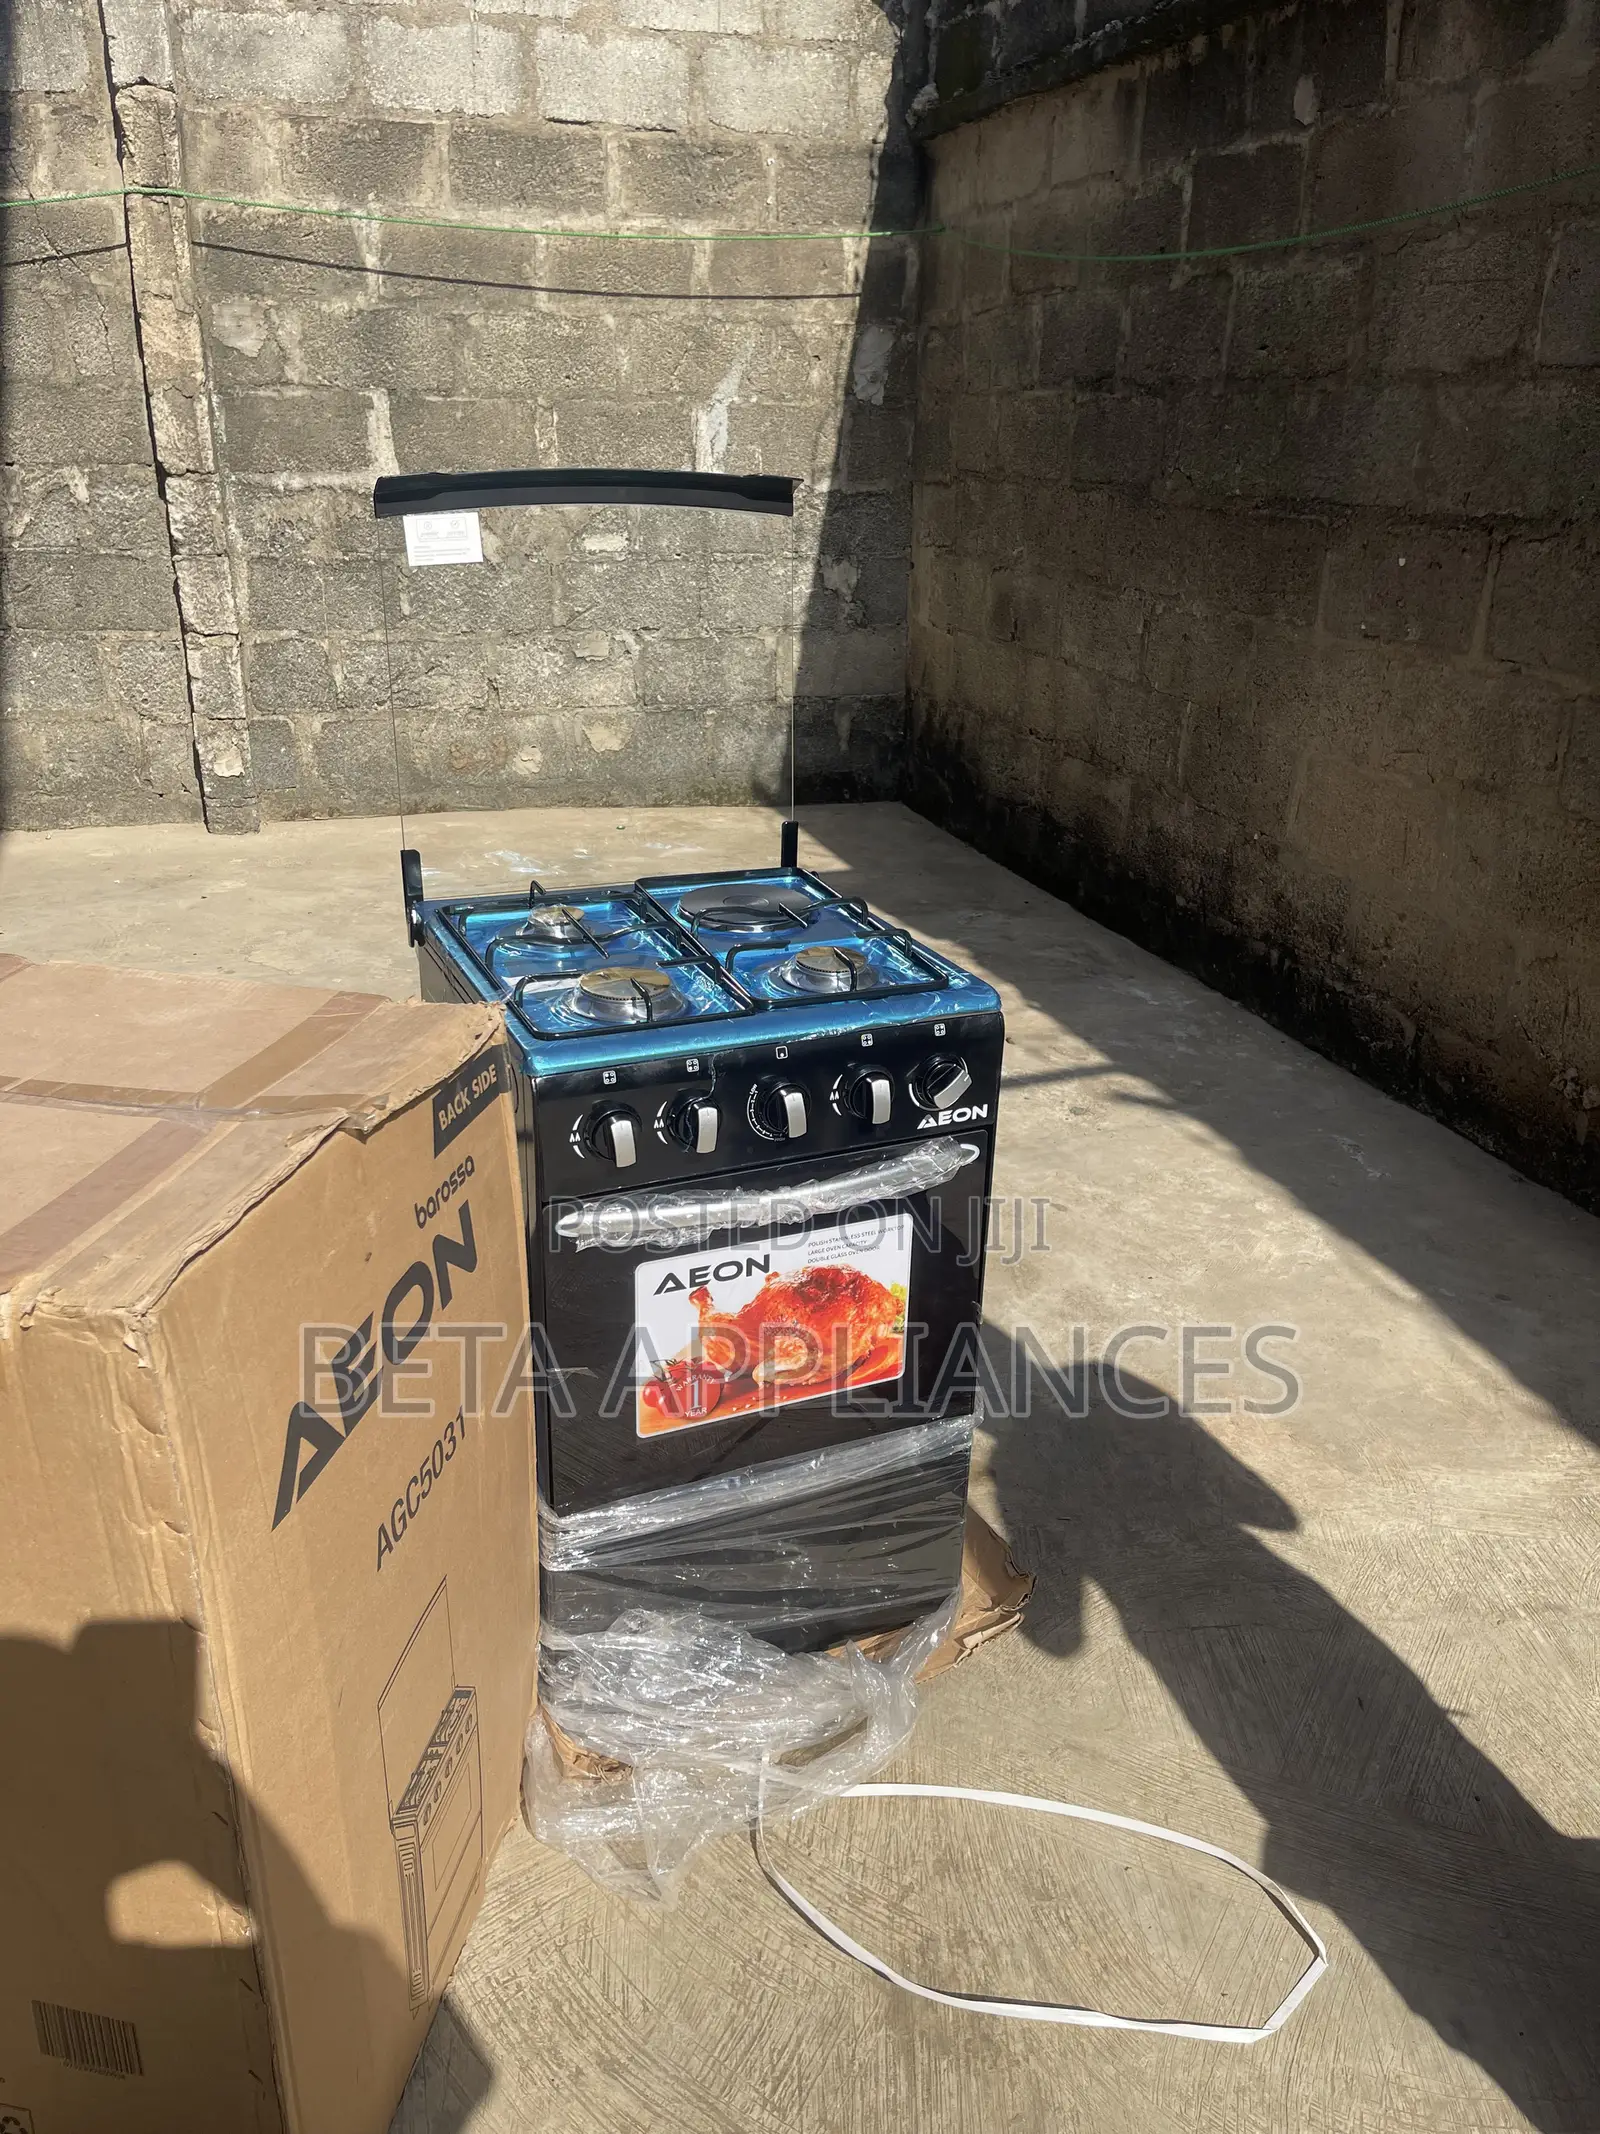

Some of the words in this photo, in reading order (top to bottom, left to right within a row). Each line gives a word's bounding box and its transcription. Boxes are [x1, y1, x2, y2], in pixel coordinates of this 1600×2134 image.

[438, 1086, 471, 1130] BACK
[472, 1063, 498, 1099] SIDE
[916, 1103, 988, 1130] AEON
[413, 1155, 476, 1229] barossa
[861, 1230, 877, 1238] STEEL
[807, 1247, 825, 1256] LARGE
[807, 1255, 830, 1264] DOUBLE
[830, 1252, 847, 1260] GLASS
[653, 1253, 770, 1295] AEON
[271, 1199, 478, 1533] AEON
[690, 1380, 702, 1410] 1
[685, 1407, 707, 1418] YEAR
[377, 1405, 466, 1573] AGC5031
